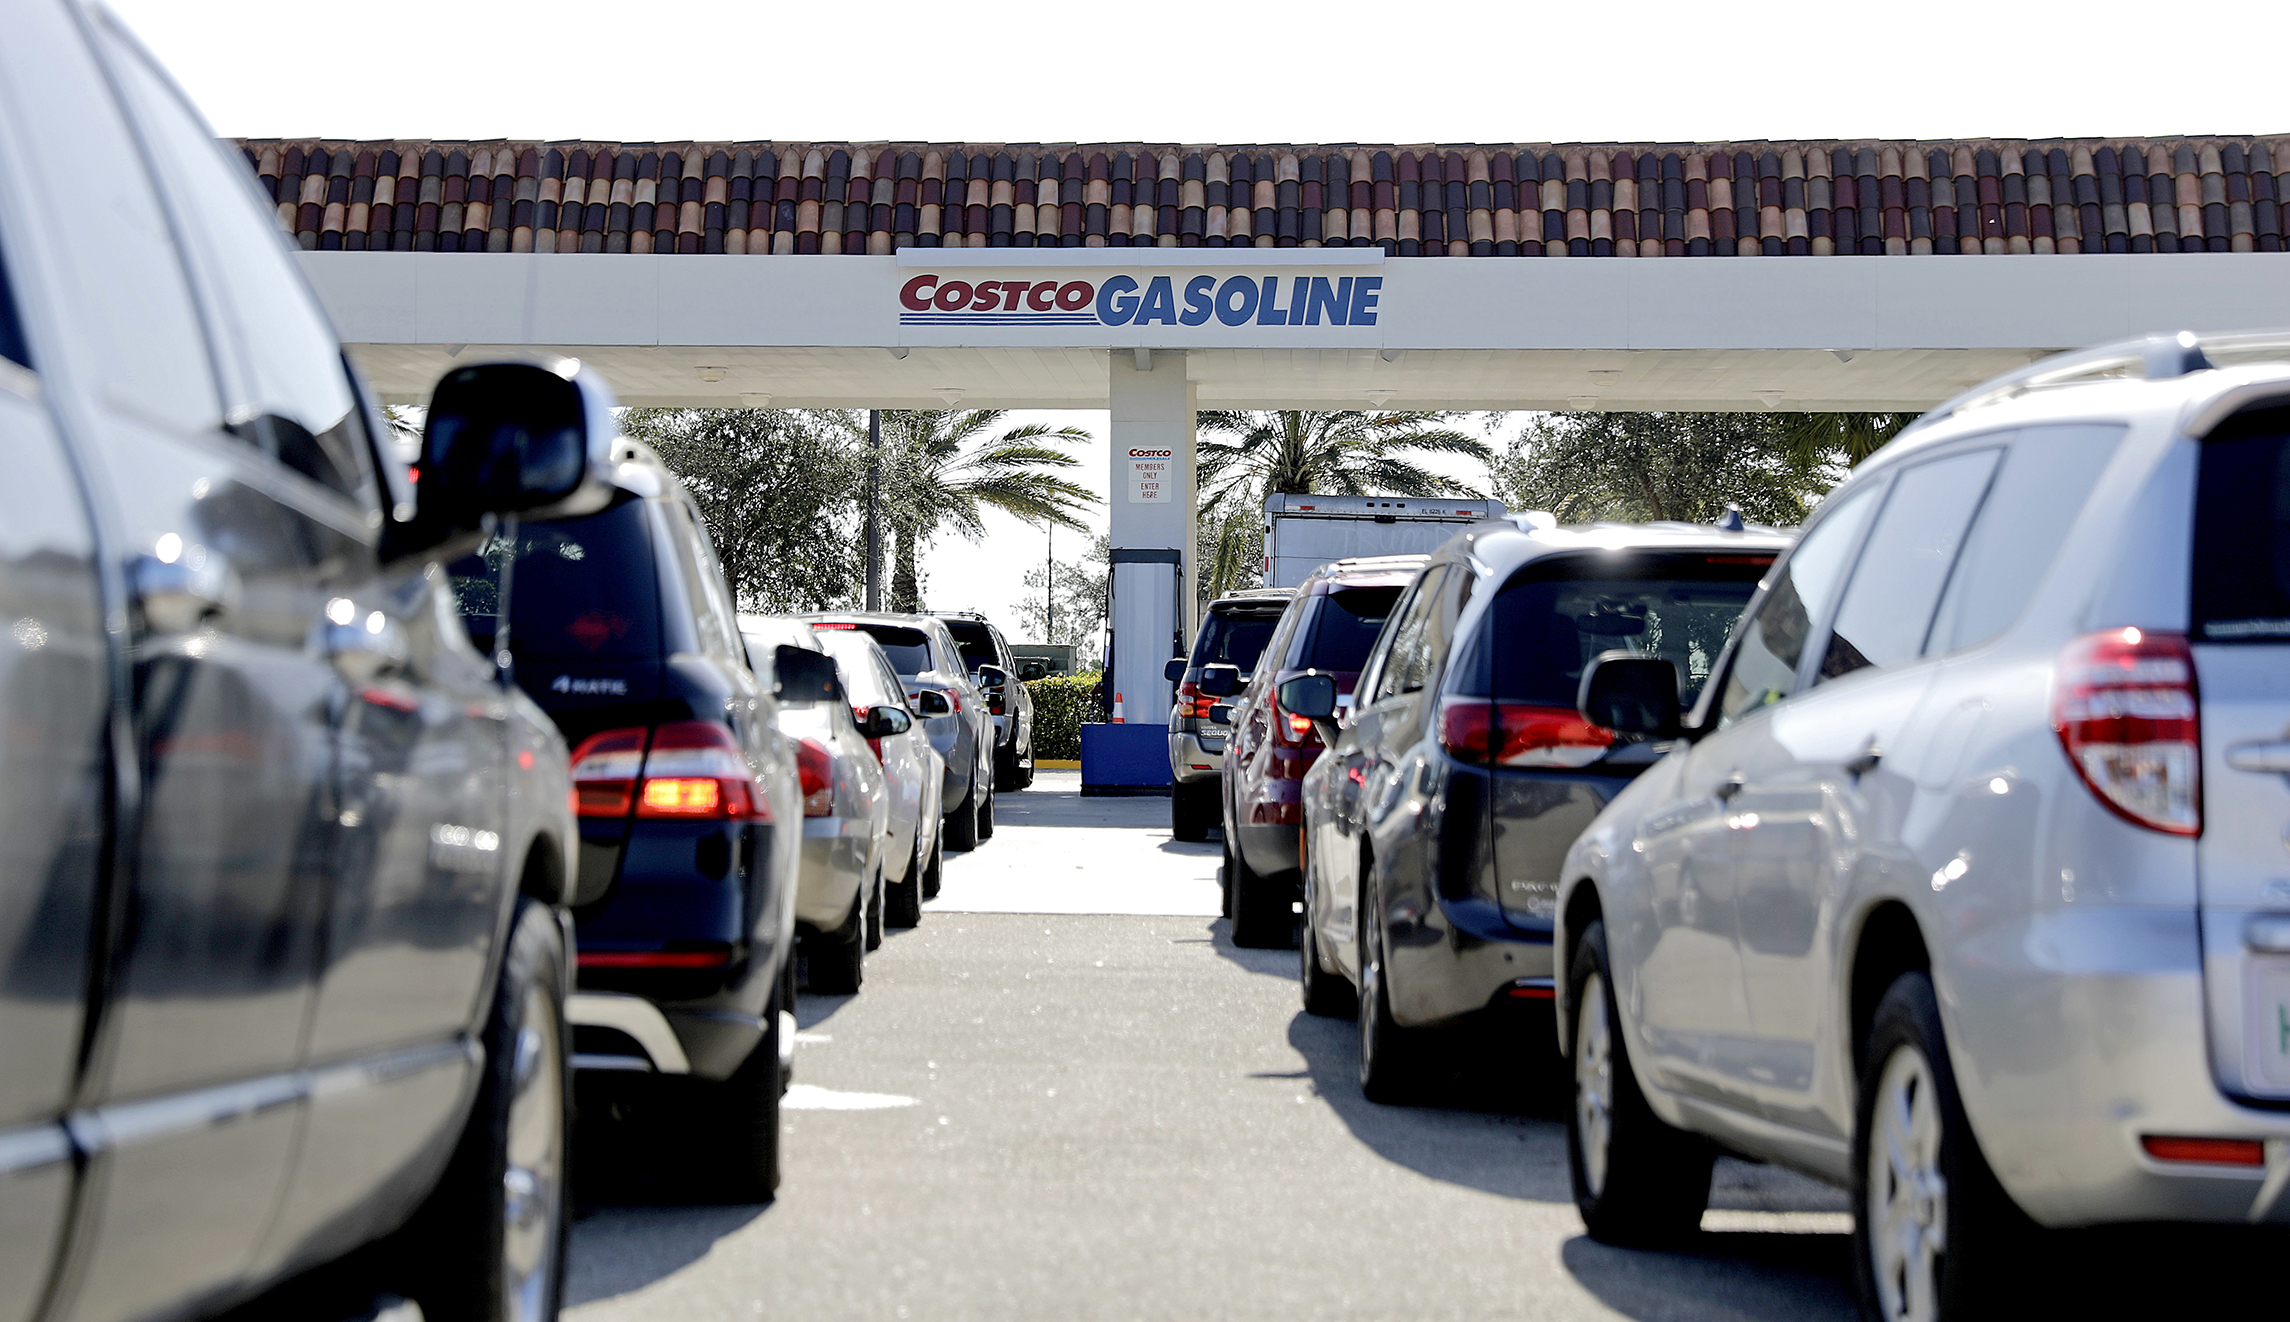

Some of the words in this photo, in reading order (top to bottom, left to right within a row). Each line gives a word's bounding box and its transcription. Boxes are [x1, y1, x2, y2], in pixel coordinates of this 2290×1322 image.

[899, 274, 1095, 311] COSTCO
[1095, 274, 1384, 327] GASOLINE
[1128, 448, 1172, 457] COSTCO
[1135, 463, 1165, 471] MEMBERS
[1140, 482, 1160, 490] ENTER
